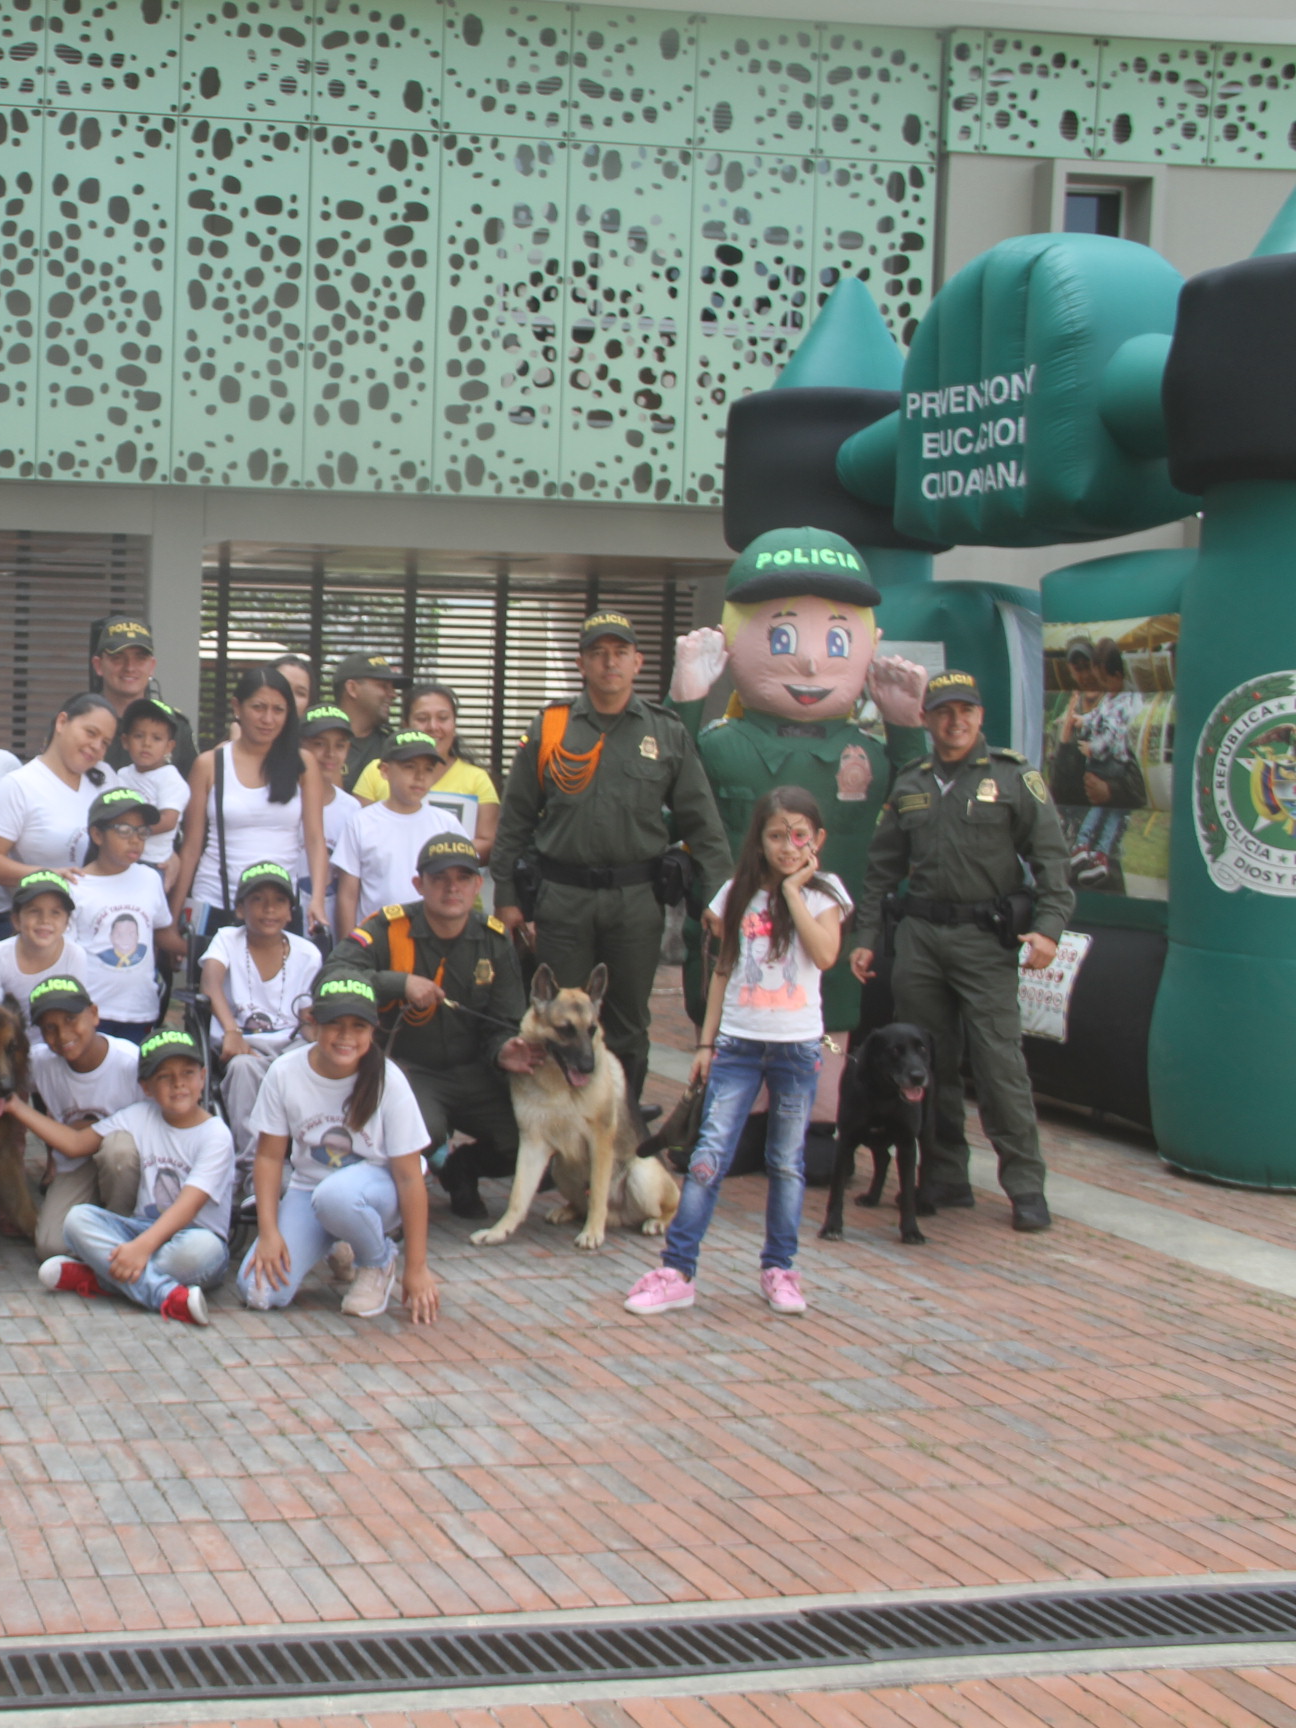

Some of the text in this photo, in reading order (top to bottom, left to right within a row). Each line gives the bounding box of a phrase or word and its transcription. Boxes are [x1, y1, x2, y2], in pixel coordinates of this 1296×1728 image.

[755, 547, 860, 572] POLICIA
[585, 614, 630, 631] POLICIA
[928, 673, 975, 692] POLICIA
[1215, 705, 1273, 790] REPUBLICA
[1220, 810, 1271, 861] POLICIA
[429, 842, 476, 857] POLICIA
[1234, 856, 1272, 883] DIOS
[30, 979, 79, 1003] POLICIA
[320, 979, 375, 1002] POLICIA
[141, 1031, 194, 1057] POLICIA
